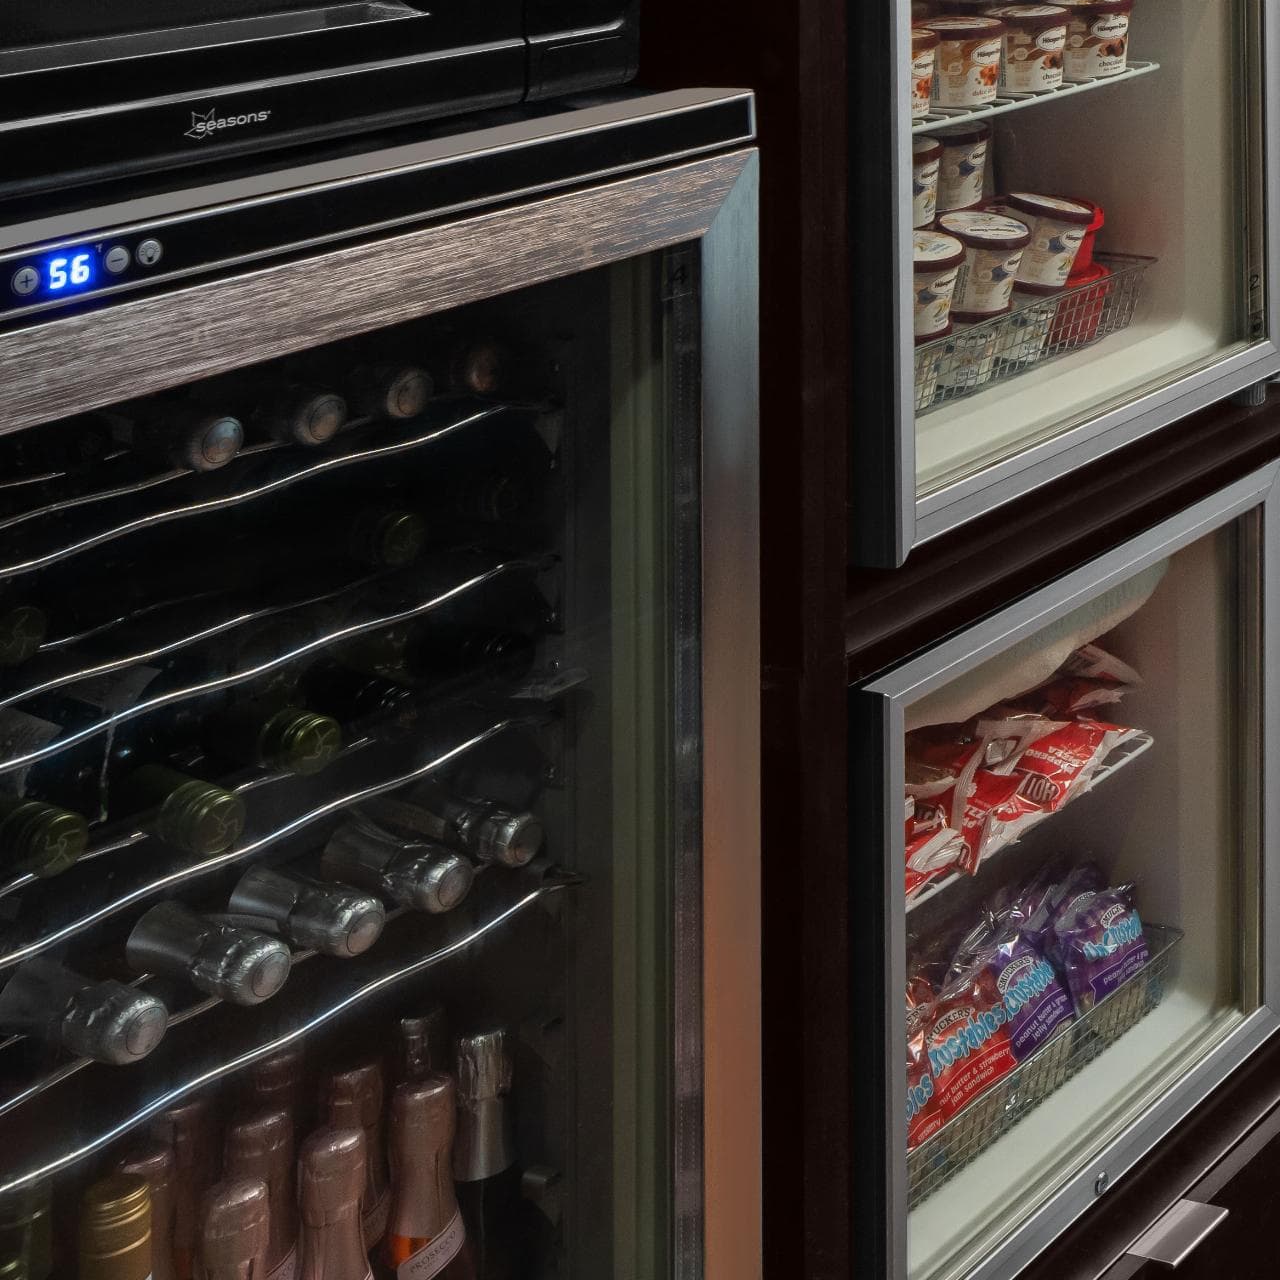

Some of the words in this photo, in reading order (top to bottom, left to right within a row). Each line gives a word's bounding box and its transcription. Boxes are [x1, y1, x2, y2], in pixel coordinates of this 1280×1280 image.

[195, 109, 269, 133] seasons
[50, 254, 91, 289] 56
[409, 1229, 457, 1274] PROSECCO
